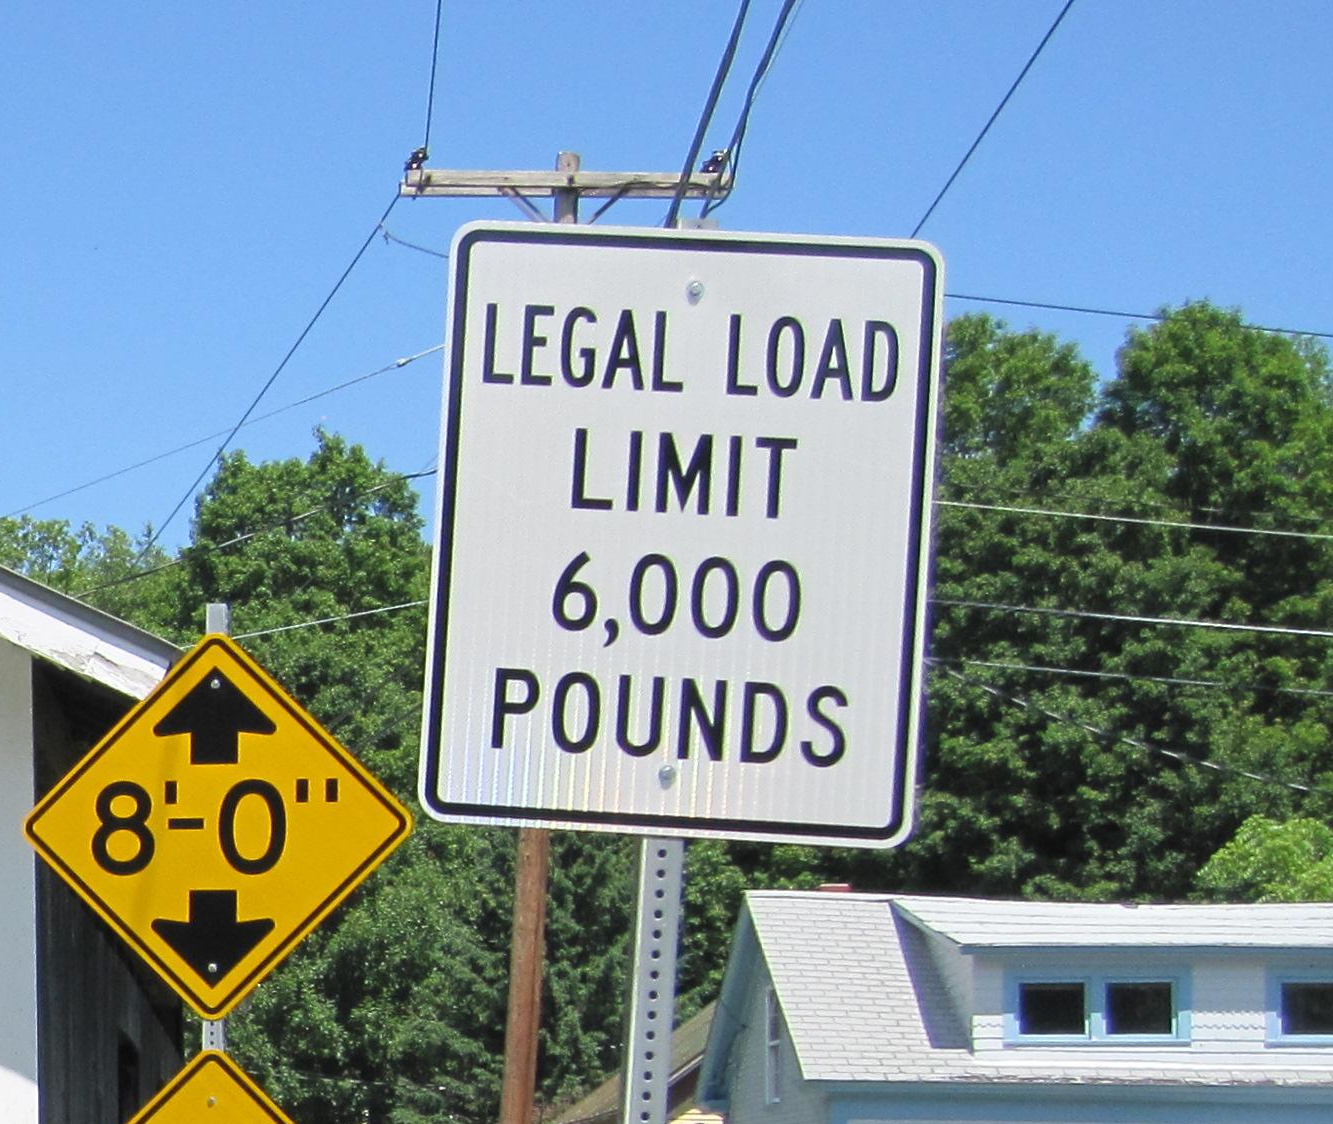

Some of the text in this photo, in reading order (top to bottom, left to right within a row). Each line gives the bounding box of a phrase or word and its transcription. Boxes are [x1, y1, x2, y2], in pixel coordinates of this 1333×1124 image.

[482, 303, 900, 402] LEGAL LOAD
[570, 427, 798, 519] LIMIT
[551, 551, 802, 647] 6,000
[490, 667, 849, 768] POUNDS
[91, 778, 339, 876] 8'-0"
